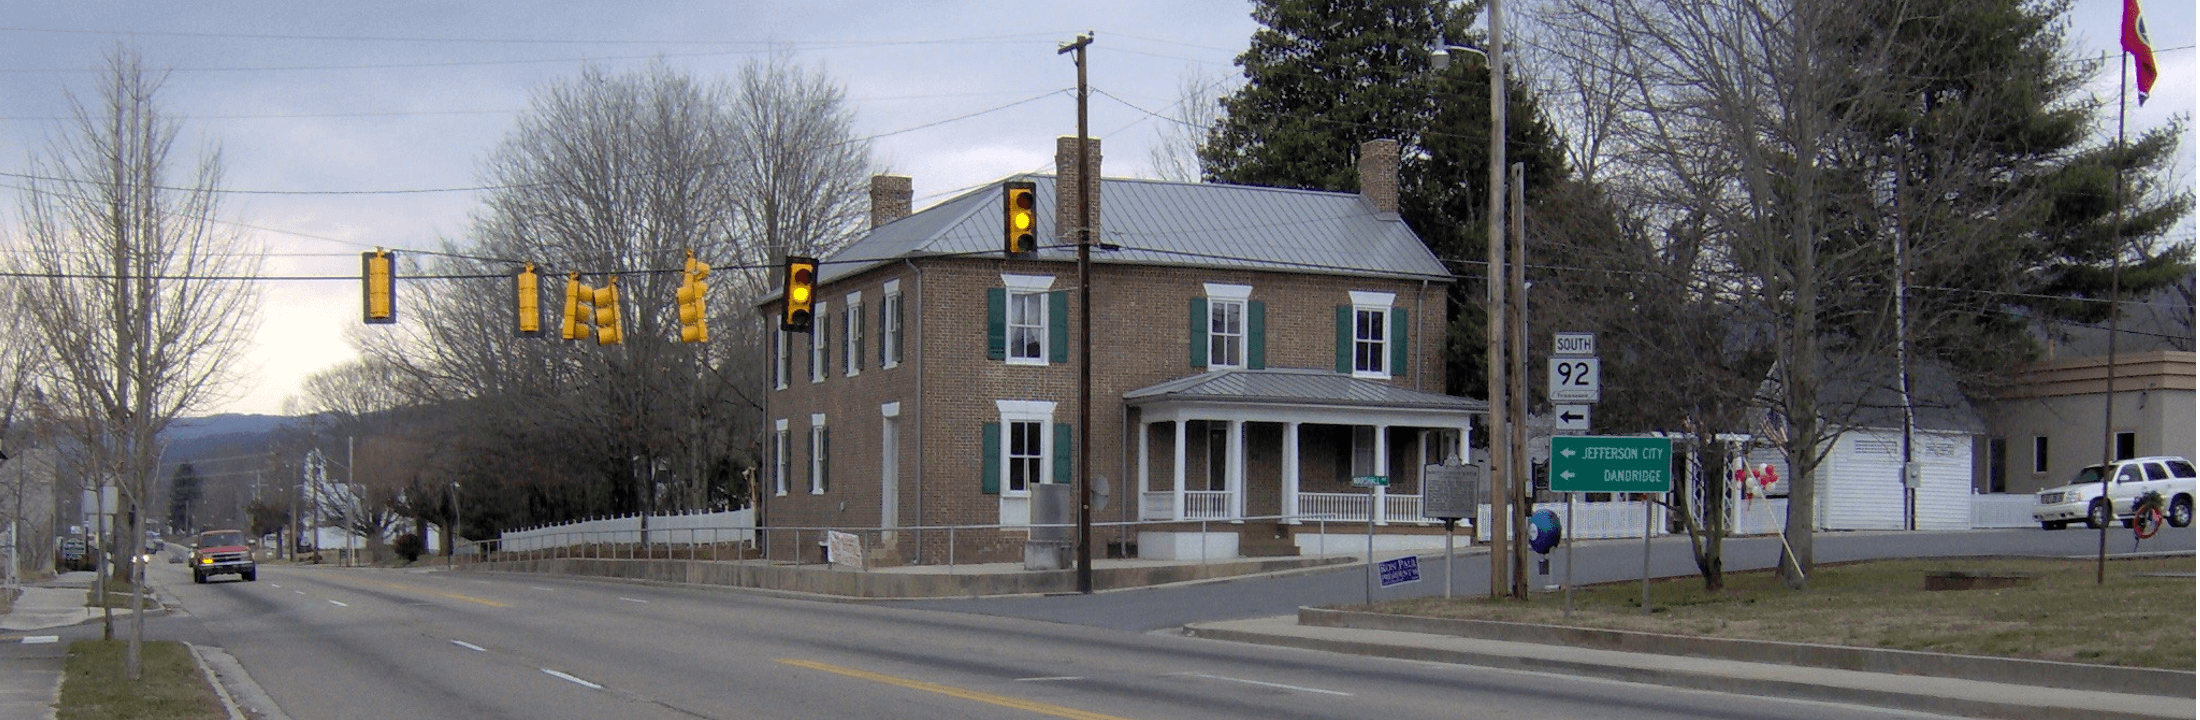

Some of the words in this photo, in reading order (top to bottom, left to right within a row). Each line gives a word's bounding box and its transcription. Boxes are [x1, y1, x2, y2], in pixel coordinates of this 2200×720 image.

[1557, 337, 1591, 351] SOUTH
[1557, 362, 1589, 385] 92
[1581, 446, 1638, 460] JEFFERSON
[1642, 446, 1663, 460] CITY
[1604, 469, 1662, 482] DANDRIDGE
